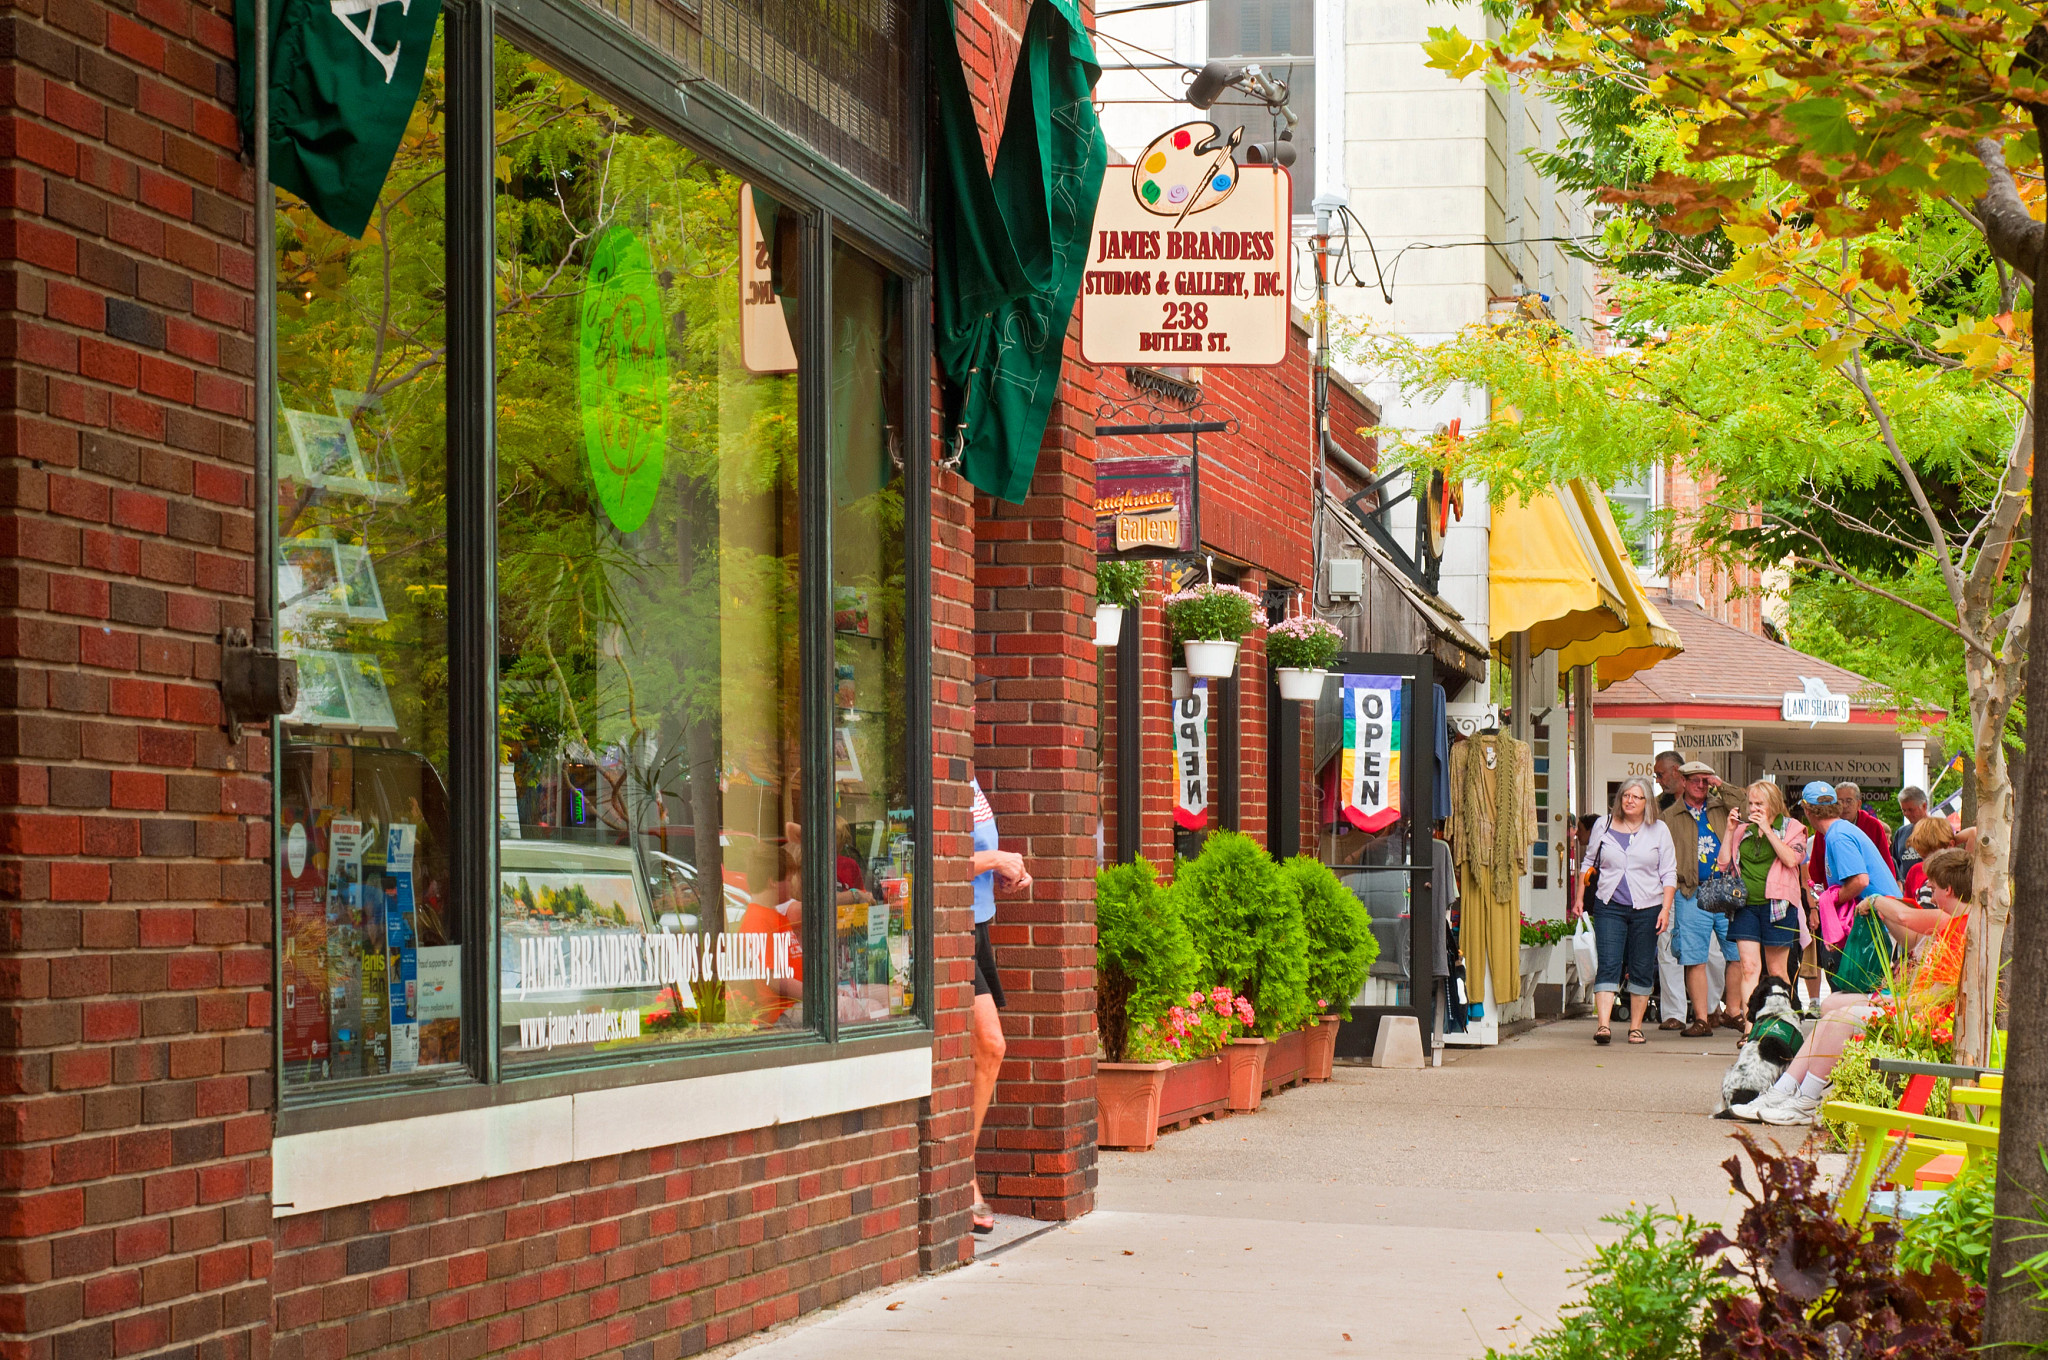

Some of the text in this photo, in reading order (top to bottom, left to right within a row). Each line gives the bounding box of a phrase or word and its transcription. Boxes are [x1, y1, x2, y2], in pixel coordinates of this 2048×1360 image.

[1097, 231, 1274, 263] JAMES BRANDESS
[1085, 271, 1285, 299] STUDIOS & GALLERY, INC.
[1162, 302, 1209, 330] 238
[1139, 332, 1231, 351] BUTLER ST.
[1093, 489, 1174, 514] aughman
[1119, 517, 1178, 545] Gallery
[1361, 694, 1384, 806] OPEN
[1674, 733, 1732, 748] ANDSHARK'S
[1627, 762, 1653, 776] 306
[1772, 758, 1891, 773] AMERICAN SPOON
[362, 949, 385, 971] Janis
[520, 936, 566, 1001] JAMES
[569, 934, 643, 988] BRANDESS
[645, 933, 699, 984] STUDIOS
[702, 932, 714, 981] &
[716, 932, 770, 985] GALLERY,
[773, 932, 795, 980] INC.
[520, 1007, 641, 1051] www.jamesbrandess.com
